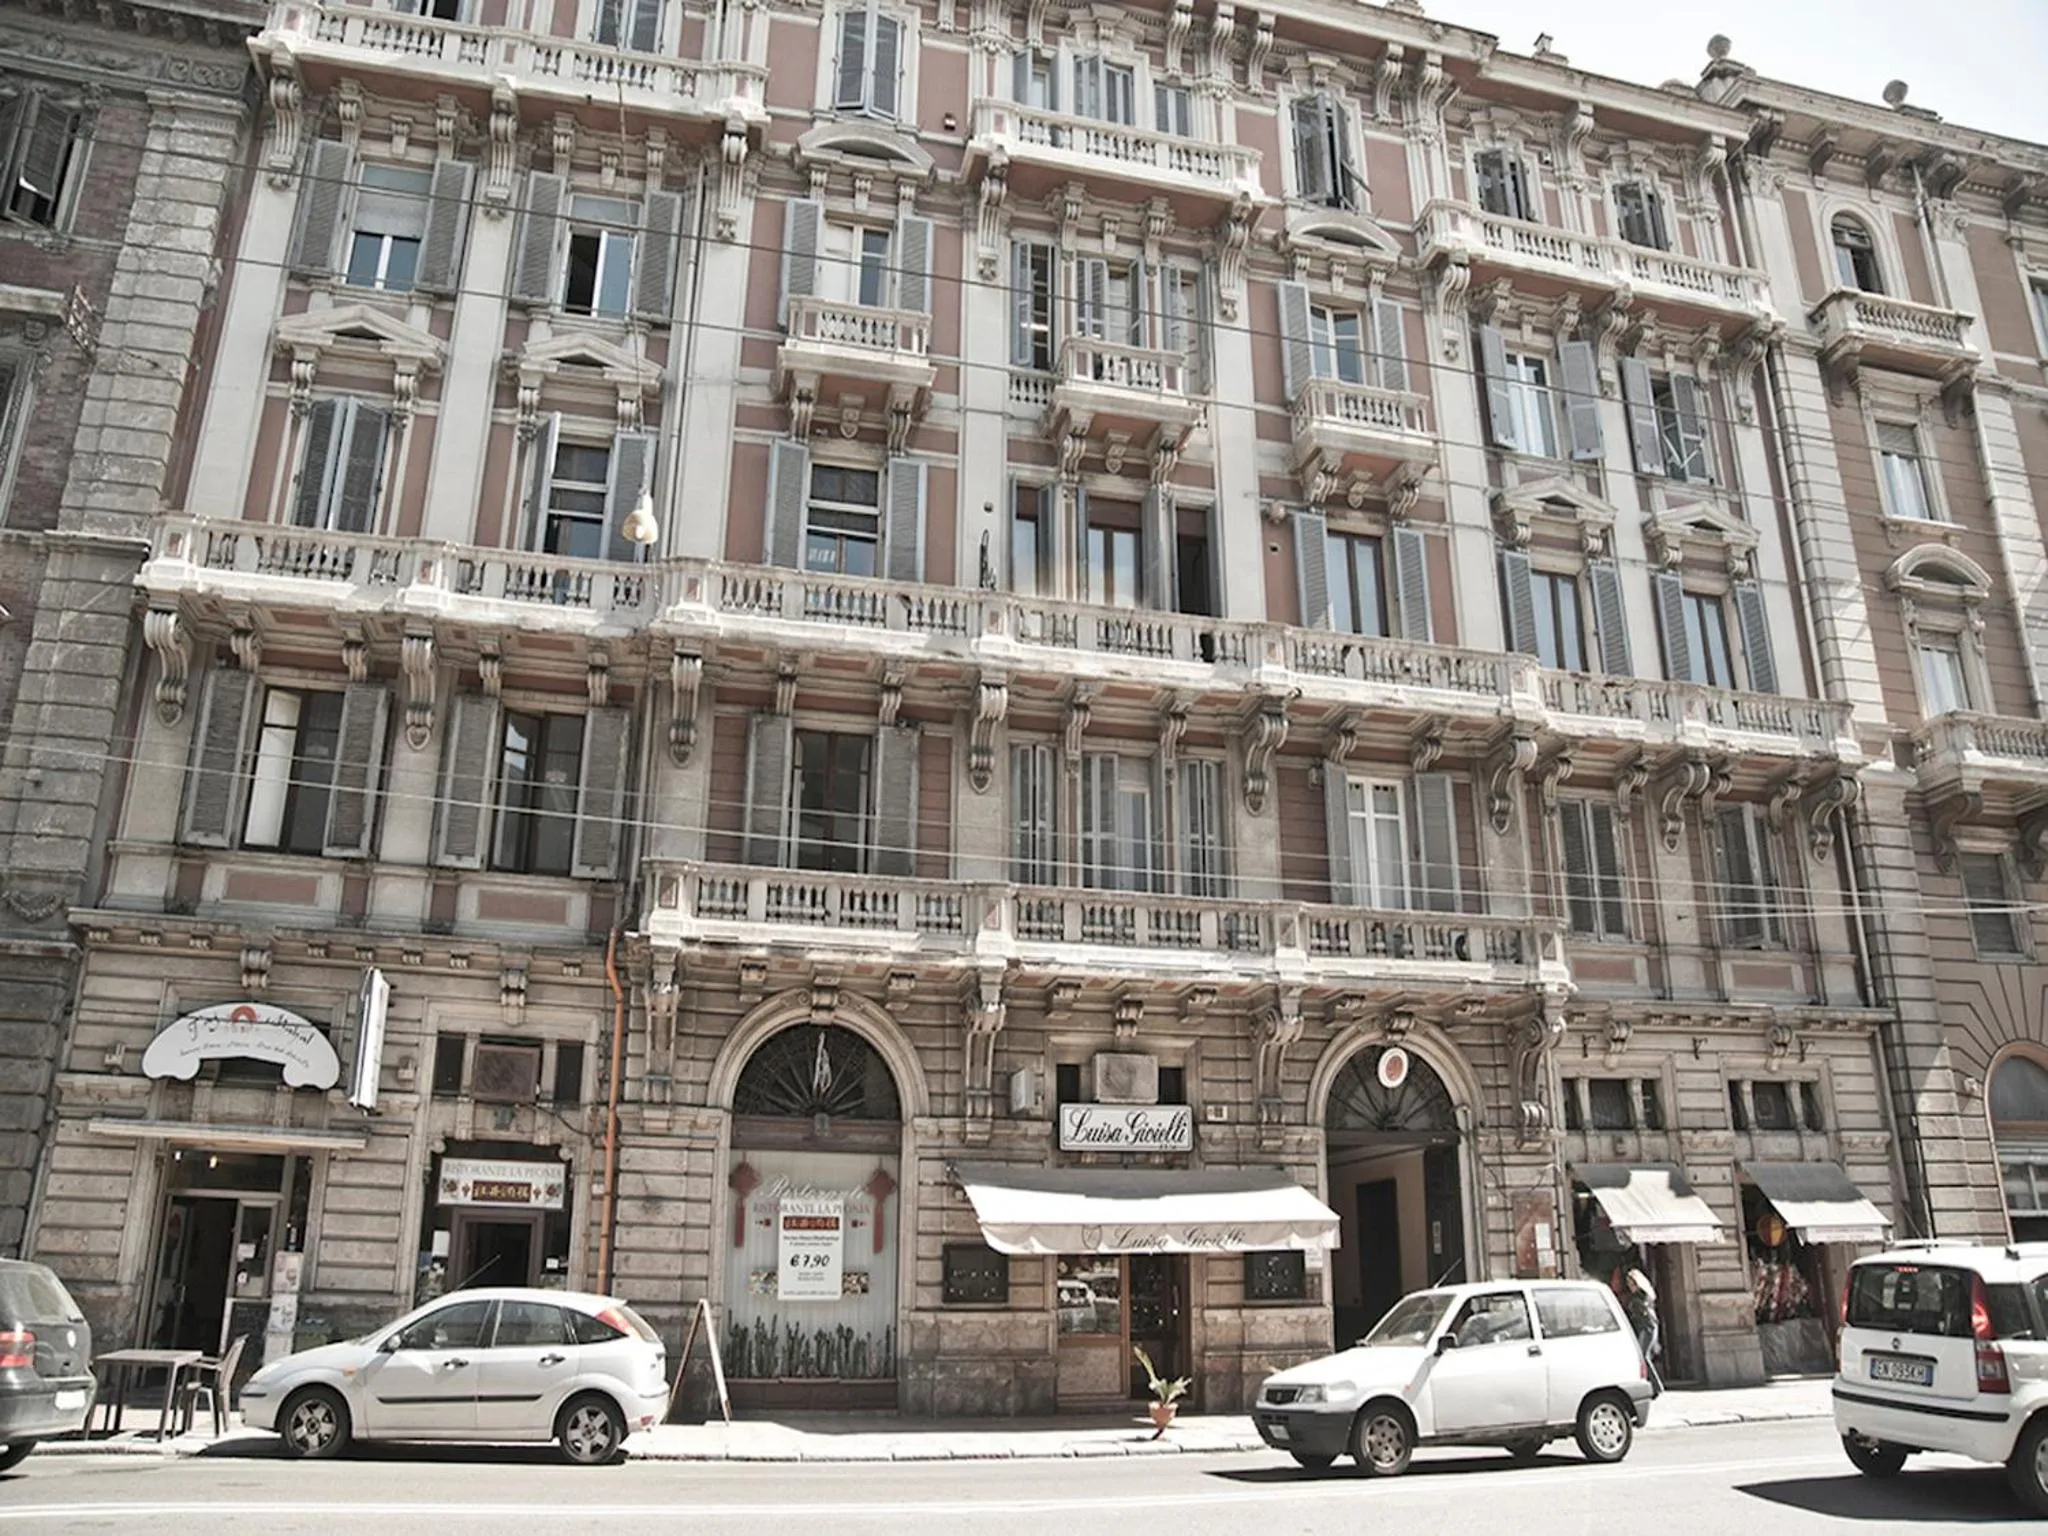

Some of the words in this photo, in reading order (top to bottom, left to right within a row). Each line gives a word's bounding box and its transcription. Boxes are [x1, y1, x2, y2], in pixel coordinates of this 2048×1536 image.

[1064, 1107, 1122, 1143] Luisa
[1125, 1110, 1187, 1145] Gioielli
[753, 1202, 817, 1214] RISTORANTE
[1113, 1226, 1168, 1249] Luisa
